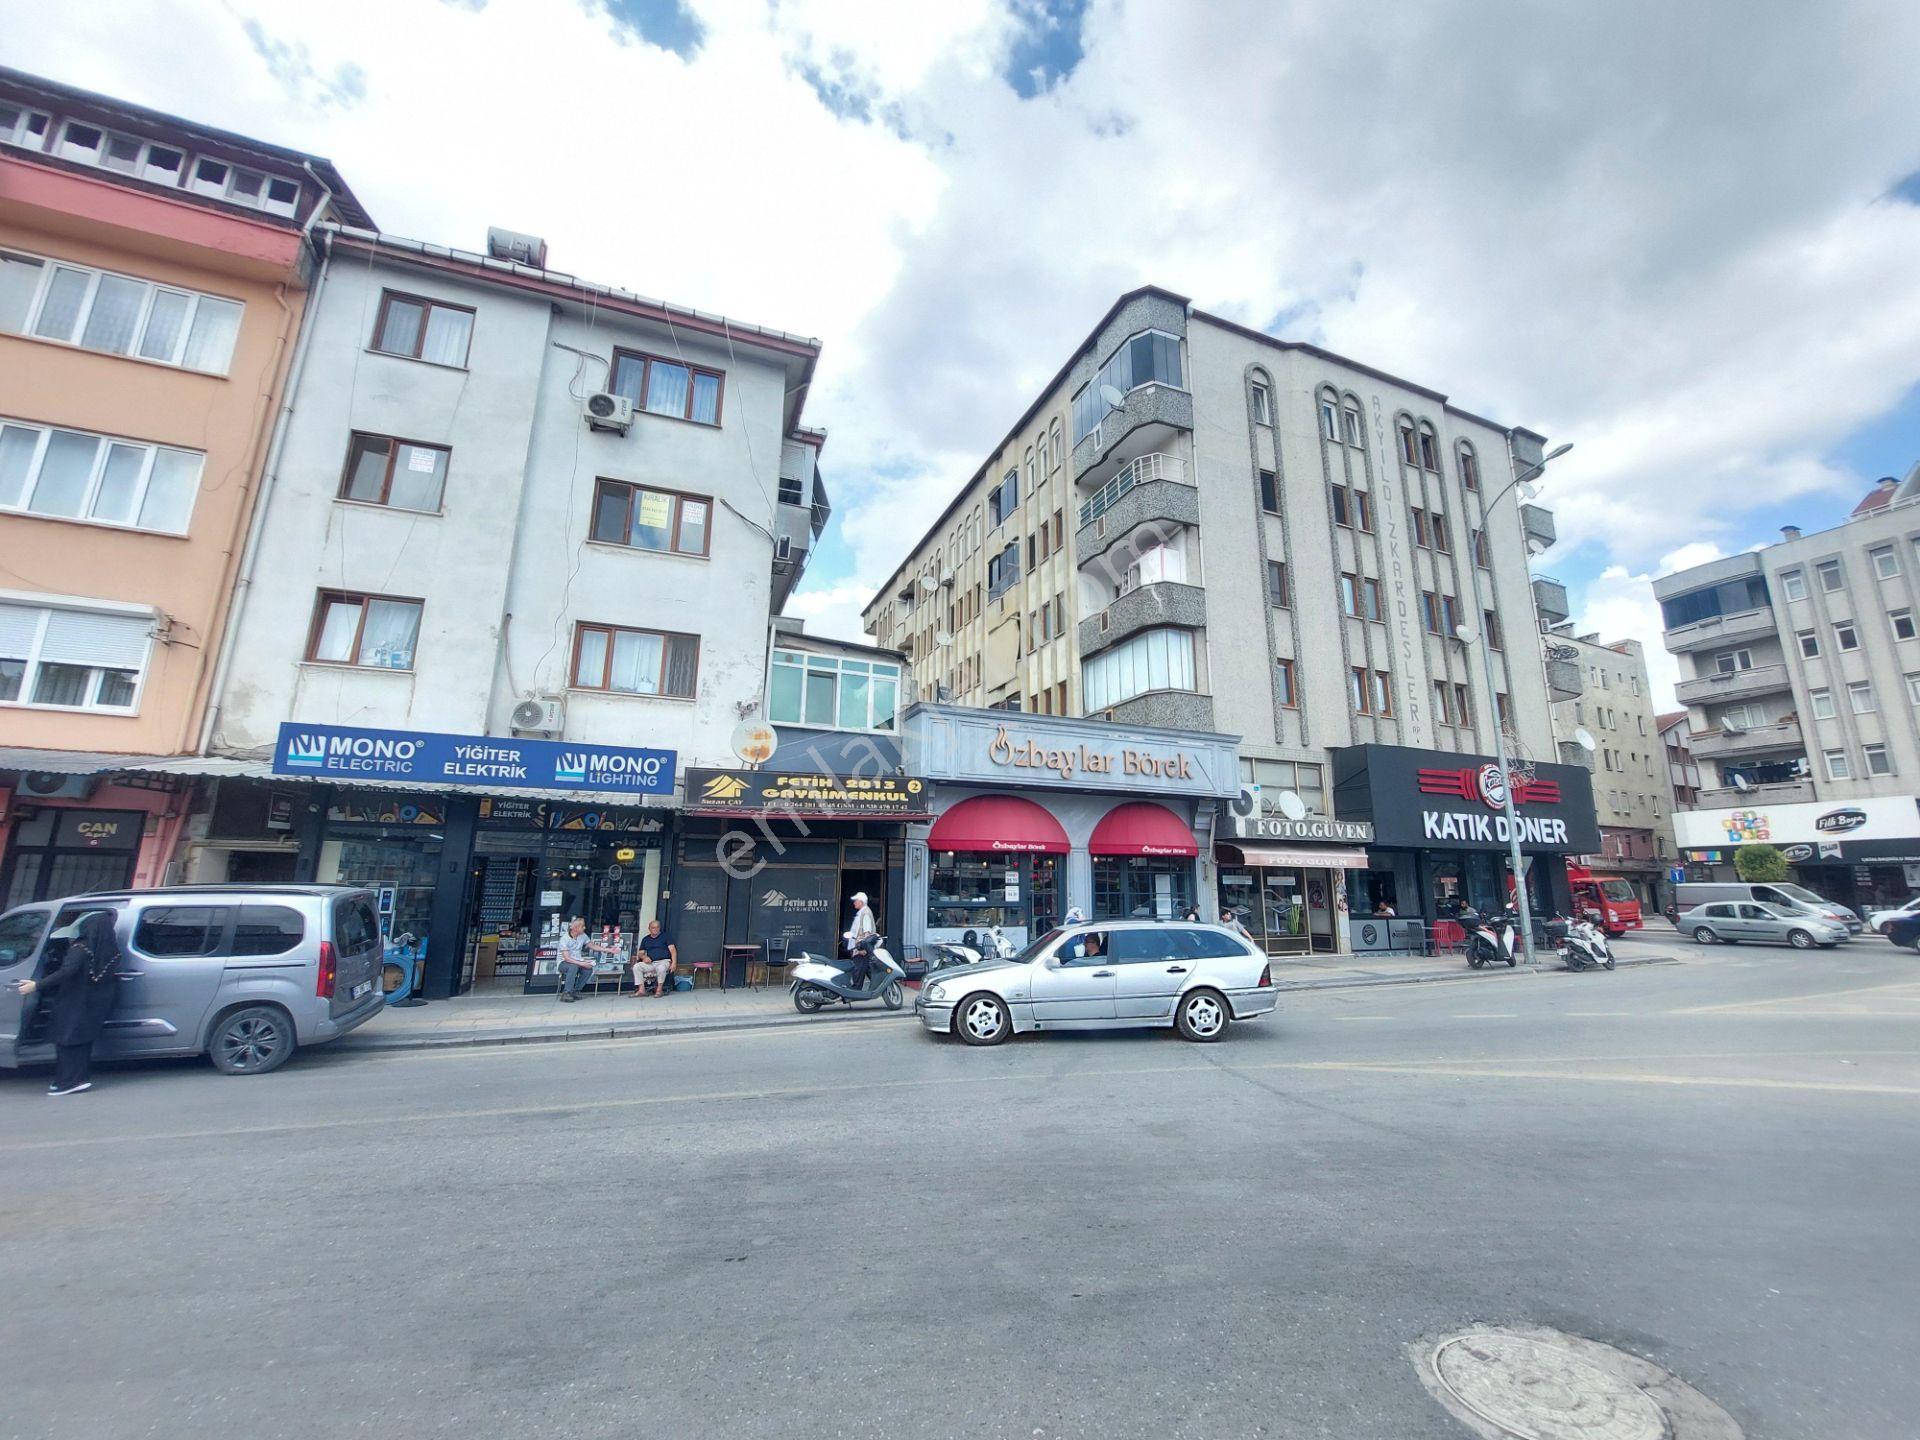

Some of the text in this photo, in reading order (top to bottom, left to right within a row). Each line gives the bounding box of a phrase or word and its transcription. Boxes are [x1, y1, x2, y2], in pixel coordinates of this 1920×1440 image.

[454, 744, 520, 763] YİĞİTER
[990, 725, 1193, 780] Özbaylar Börek
[327, 757, 413, 773] ELECTRIC
[443, 762, 527, 779] ELEKTRİK
[776, 775, 833, 788] FETİH
[845, 778, 896, 789] 2013
[761, 788, 909, 802] GAYRİMENKUL
[78, 822, 118, 834] CAN
[1423, 810, 1568, 844] KATIK DÖNER
[807, 899, 828, 907] 2013
